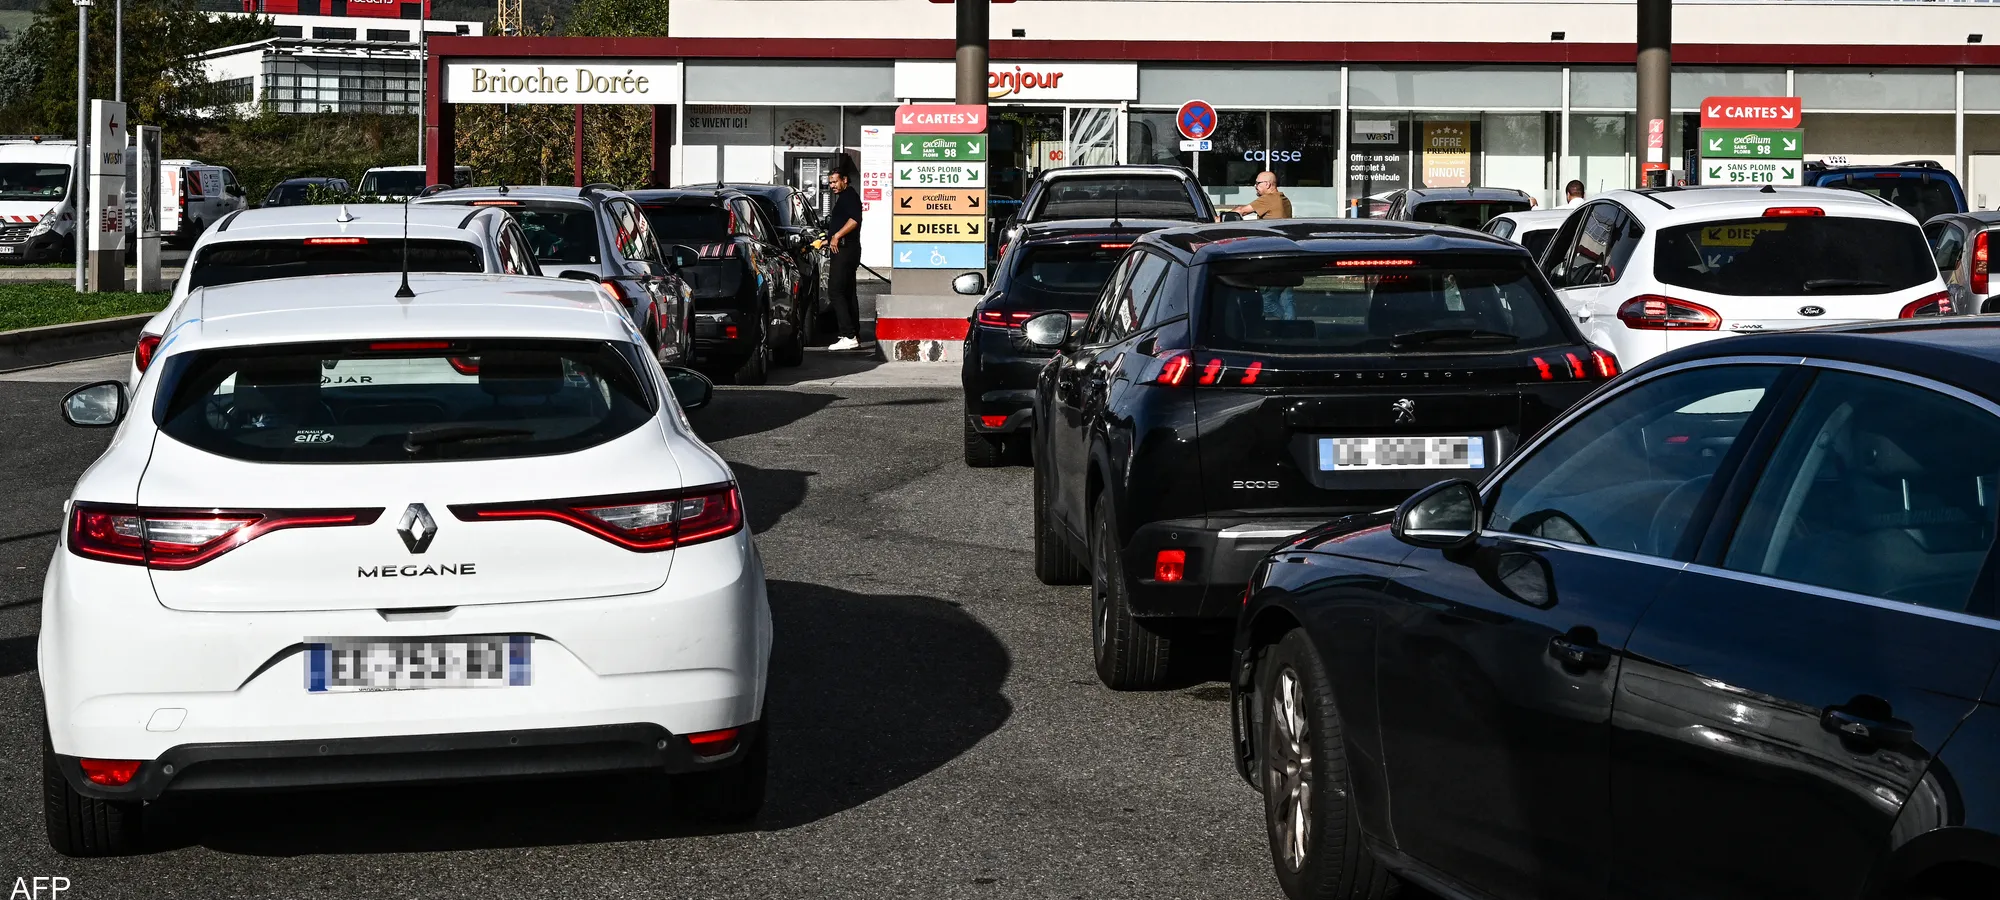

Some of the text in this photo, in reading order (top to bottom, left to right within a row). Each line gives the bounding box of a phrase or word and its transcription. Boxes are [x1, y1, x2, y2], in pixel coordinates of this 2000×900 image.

[471, 66, 650, 93] Brioche Dorée
[988, 65, 1064, 95] onjour
[1725, 106, 1778, 119] CARTES
[689, 117, 700, 129] SE
[701, 117, 731, 128] VIVENT
[732, 118, 743, 128] ICI
[917, 113, 965, 124] CARTES
[1366, 132, 1395, 141] wash
[1431, 136, 1462, 147] OFFRE
[1733, 134, 1771, 145] excellium
[922, 140, 957, 148] excellium
[944, 148, 957, 158] 98
[1426, 147, 1467, 155] PREMIUM
[1757, 145, 1771, 155] 98
[103, 148, 123, 165] wash
[1243, 150, 1302, 162] casse
[1350, 153, 1373, 162] Offrez
[1384, 153, 1400, 162] soin
[1350, 163, 1386, 173] complet à
[1727, 163, 1777, 171] SANS PLOMB
[1350, 173, 1400, 181] votre véhicule
[1428, 167, 1466, 178] INNOVE
[1729, 171, 1774, 183] 95-E10
[919, 173, 960, 184] 95-E10
[922, 193, 957, 202] excellium
[926, 203, 953, 211] DIESEL
[917, 223, 961, 235] DIESEL
[1333, 371, 1474, 379] PEUGEOT
[294, 433, 320, 443] elf
[1232, 480, 1280, 489] 2008
[357, 562, 477, 578] MEGANE
